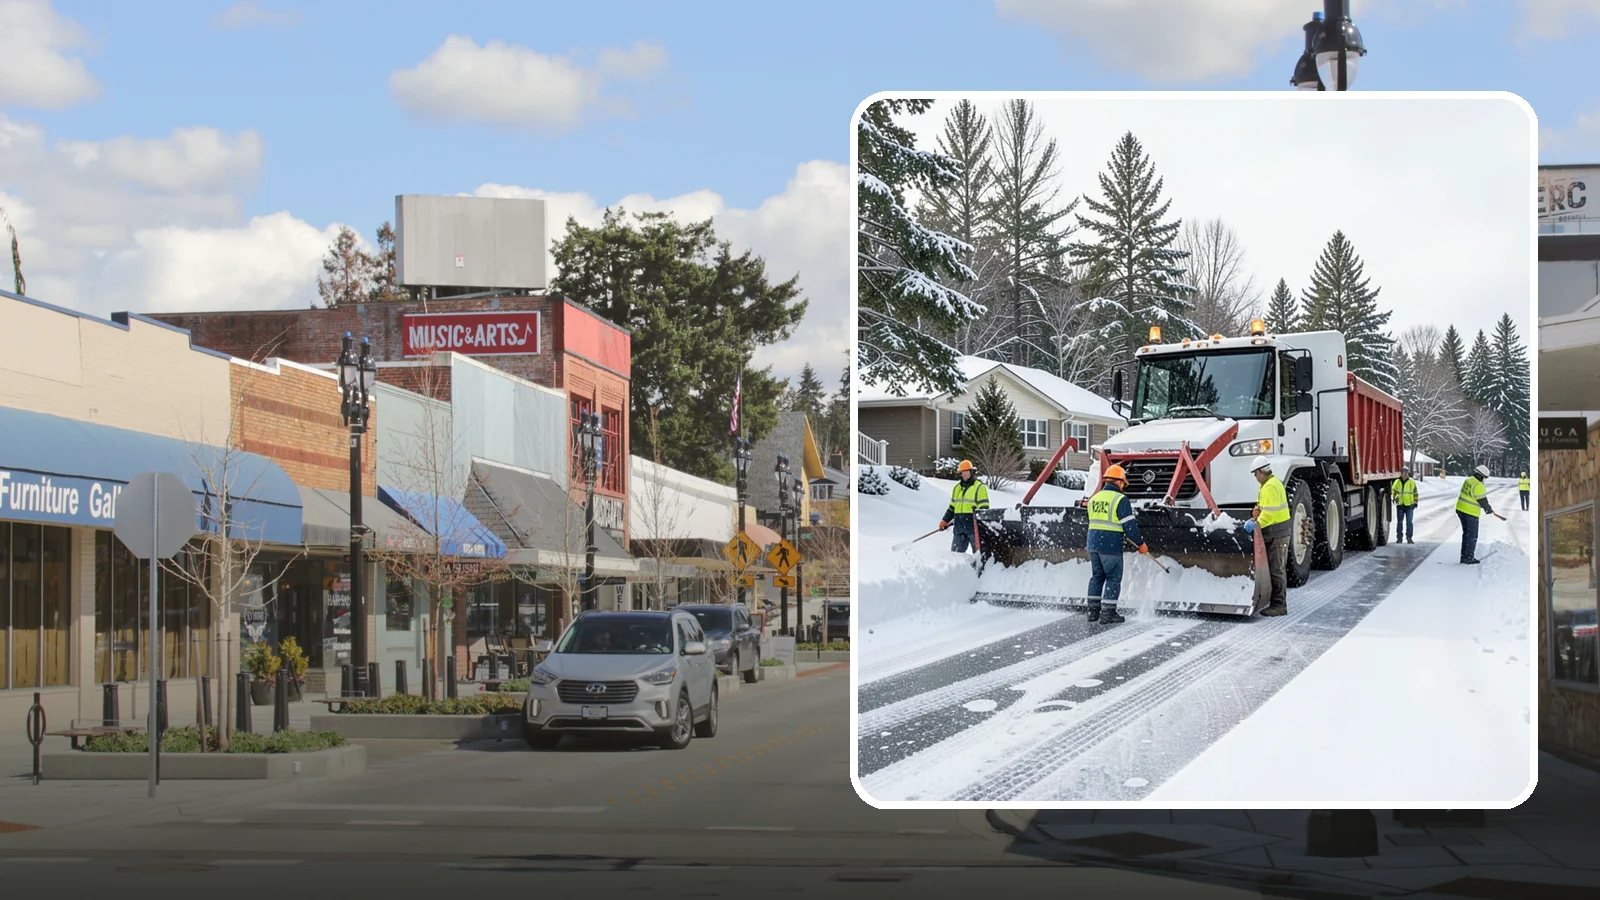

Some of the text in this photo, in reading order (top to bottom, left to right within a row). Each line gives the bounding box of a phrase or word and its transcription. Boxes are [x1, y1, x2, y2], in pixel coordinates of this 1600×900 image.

[0, 471, 121, 519] Furniture Gal
[453, 562, 479, 574] SUSHI
